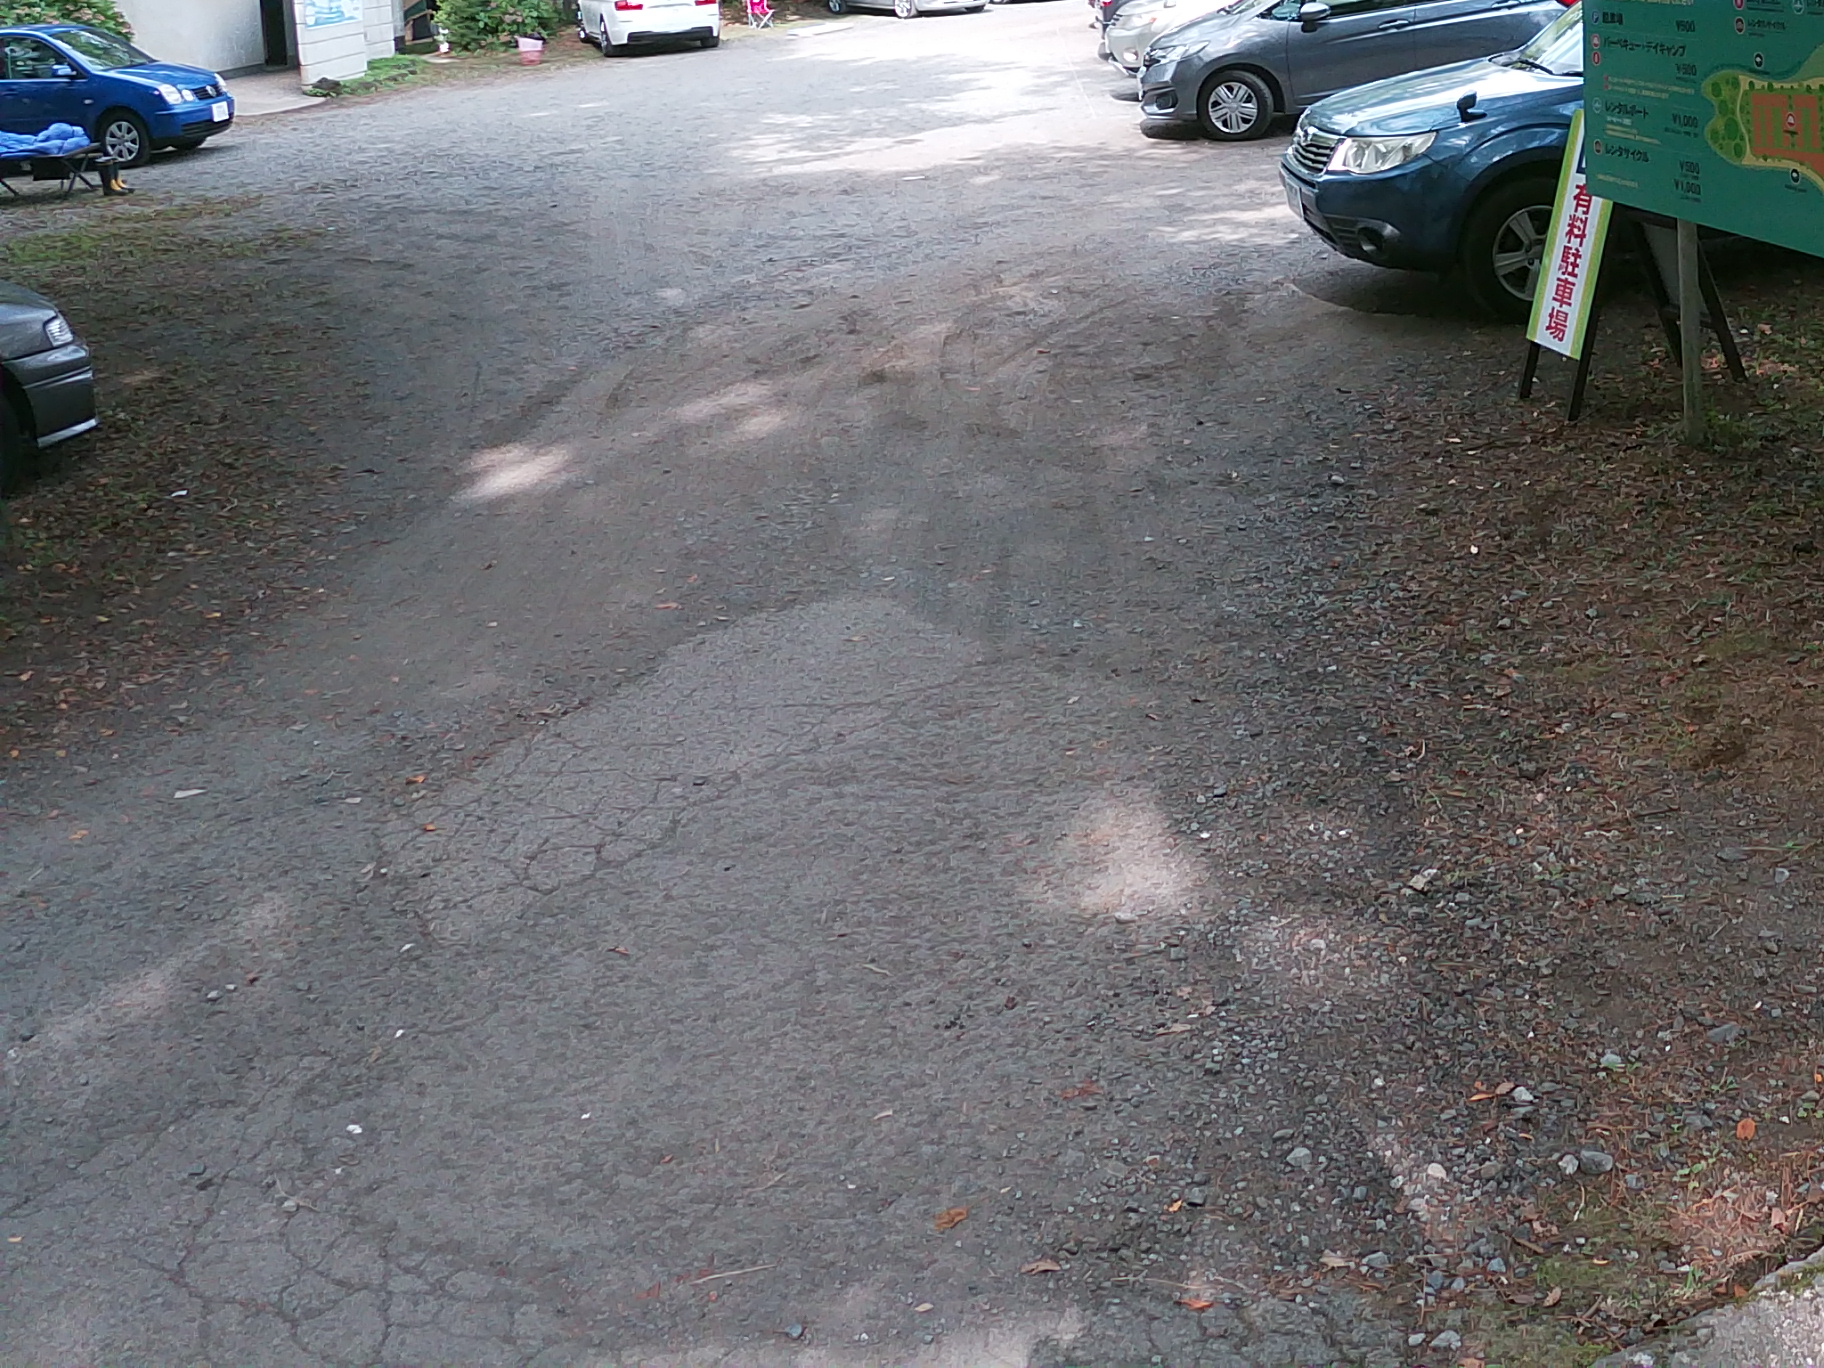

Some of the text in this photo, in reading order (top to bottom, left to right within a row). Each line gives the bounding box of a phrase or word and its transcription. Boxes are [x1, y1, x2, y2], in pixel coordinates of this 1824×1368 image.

[1545, 183, 1593, 342] 有料駐車場
